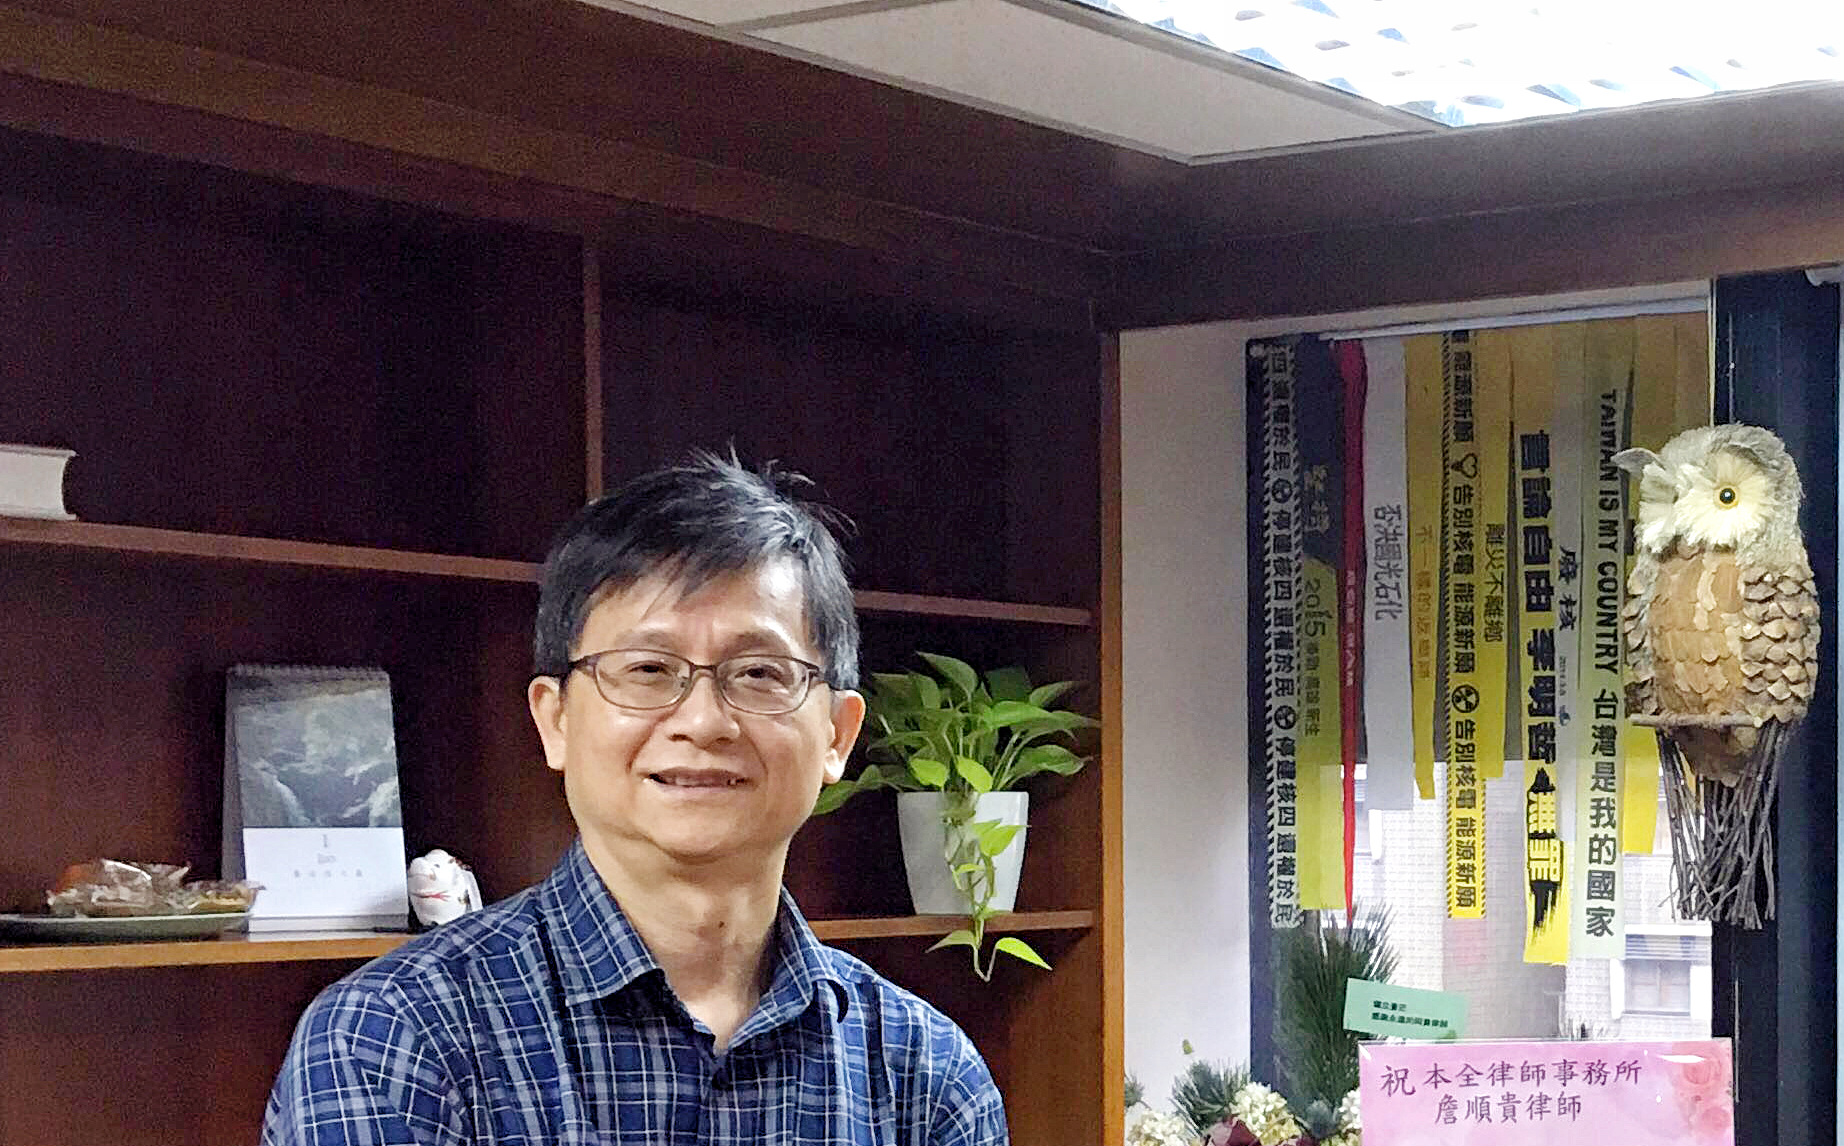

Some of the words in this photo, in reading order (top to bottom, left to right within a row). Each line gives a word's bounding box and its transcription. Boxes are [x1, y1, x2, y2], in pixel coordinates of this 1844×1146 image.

[1600, 389, 1619, 482] TAIWAN
[1453, 484, 1474, 575] 告別核電
[1520, 429, 1554, 613] 言論自由
[1598, 519, 1618, 553] MY
[1599, 490, 1618, 511] IS
[1272, 508, 1293, 600] 停建核四
[1373, 504, 1403, 621] 否決國光石化
[1558, 546, 1579, 632] 廢核
[1454, 583, 1475, 674] 能源新願
[1595, 561, 1618, 675] COUNTRY
[1527, 628, 1557, 764] 李明哲
[1276, 735, 1296, 827] 停建核四
[1455, 718, 1477, 809] 告別核電
[1527, 791, 1564, 882] 無罪
[1585, 688, 1619, 938] 台灣是我的國家
[1276, 833, 1297, 924] 還權於民
[1456, 816, 1477, 908] 能源新願
[1379, 1064, 1416, 1098] 祝
[1423, 1059, 1642, 1090] 本全律師事務所
[1434, 1091, 1582, 1126] 詹順貴律師
